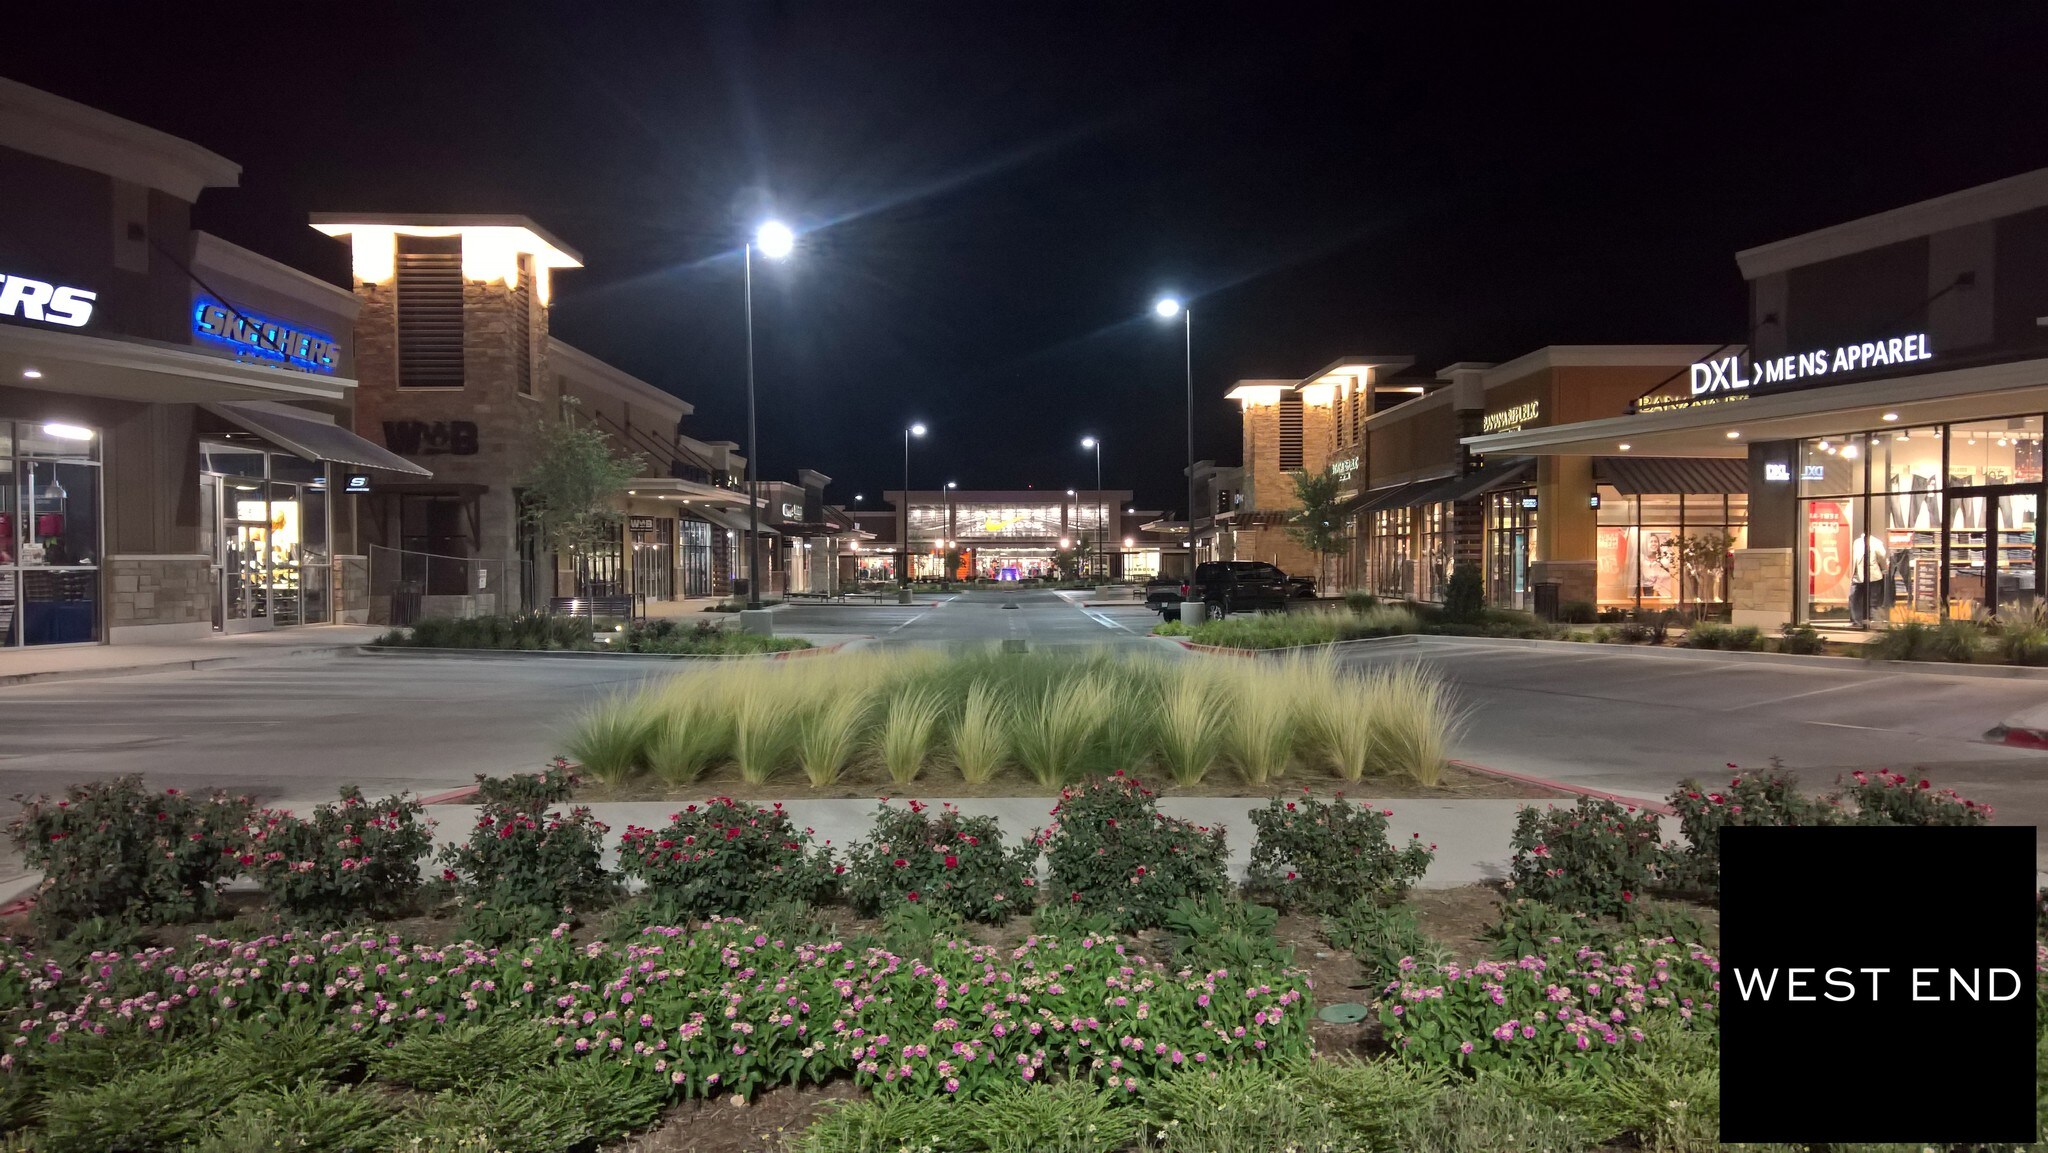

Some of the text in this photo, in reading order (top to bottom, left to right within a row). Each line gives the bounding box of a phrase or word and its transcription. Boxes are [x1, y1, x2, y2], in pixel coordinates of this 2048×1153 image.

[0, 274, 97, 327] RS
[199, 303, 341, 368] SKECHERS
[1690, 356, 1749, 395] DXL
[1832, 333, 1932, 373] APPAREL
